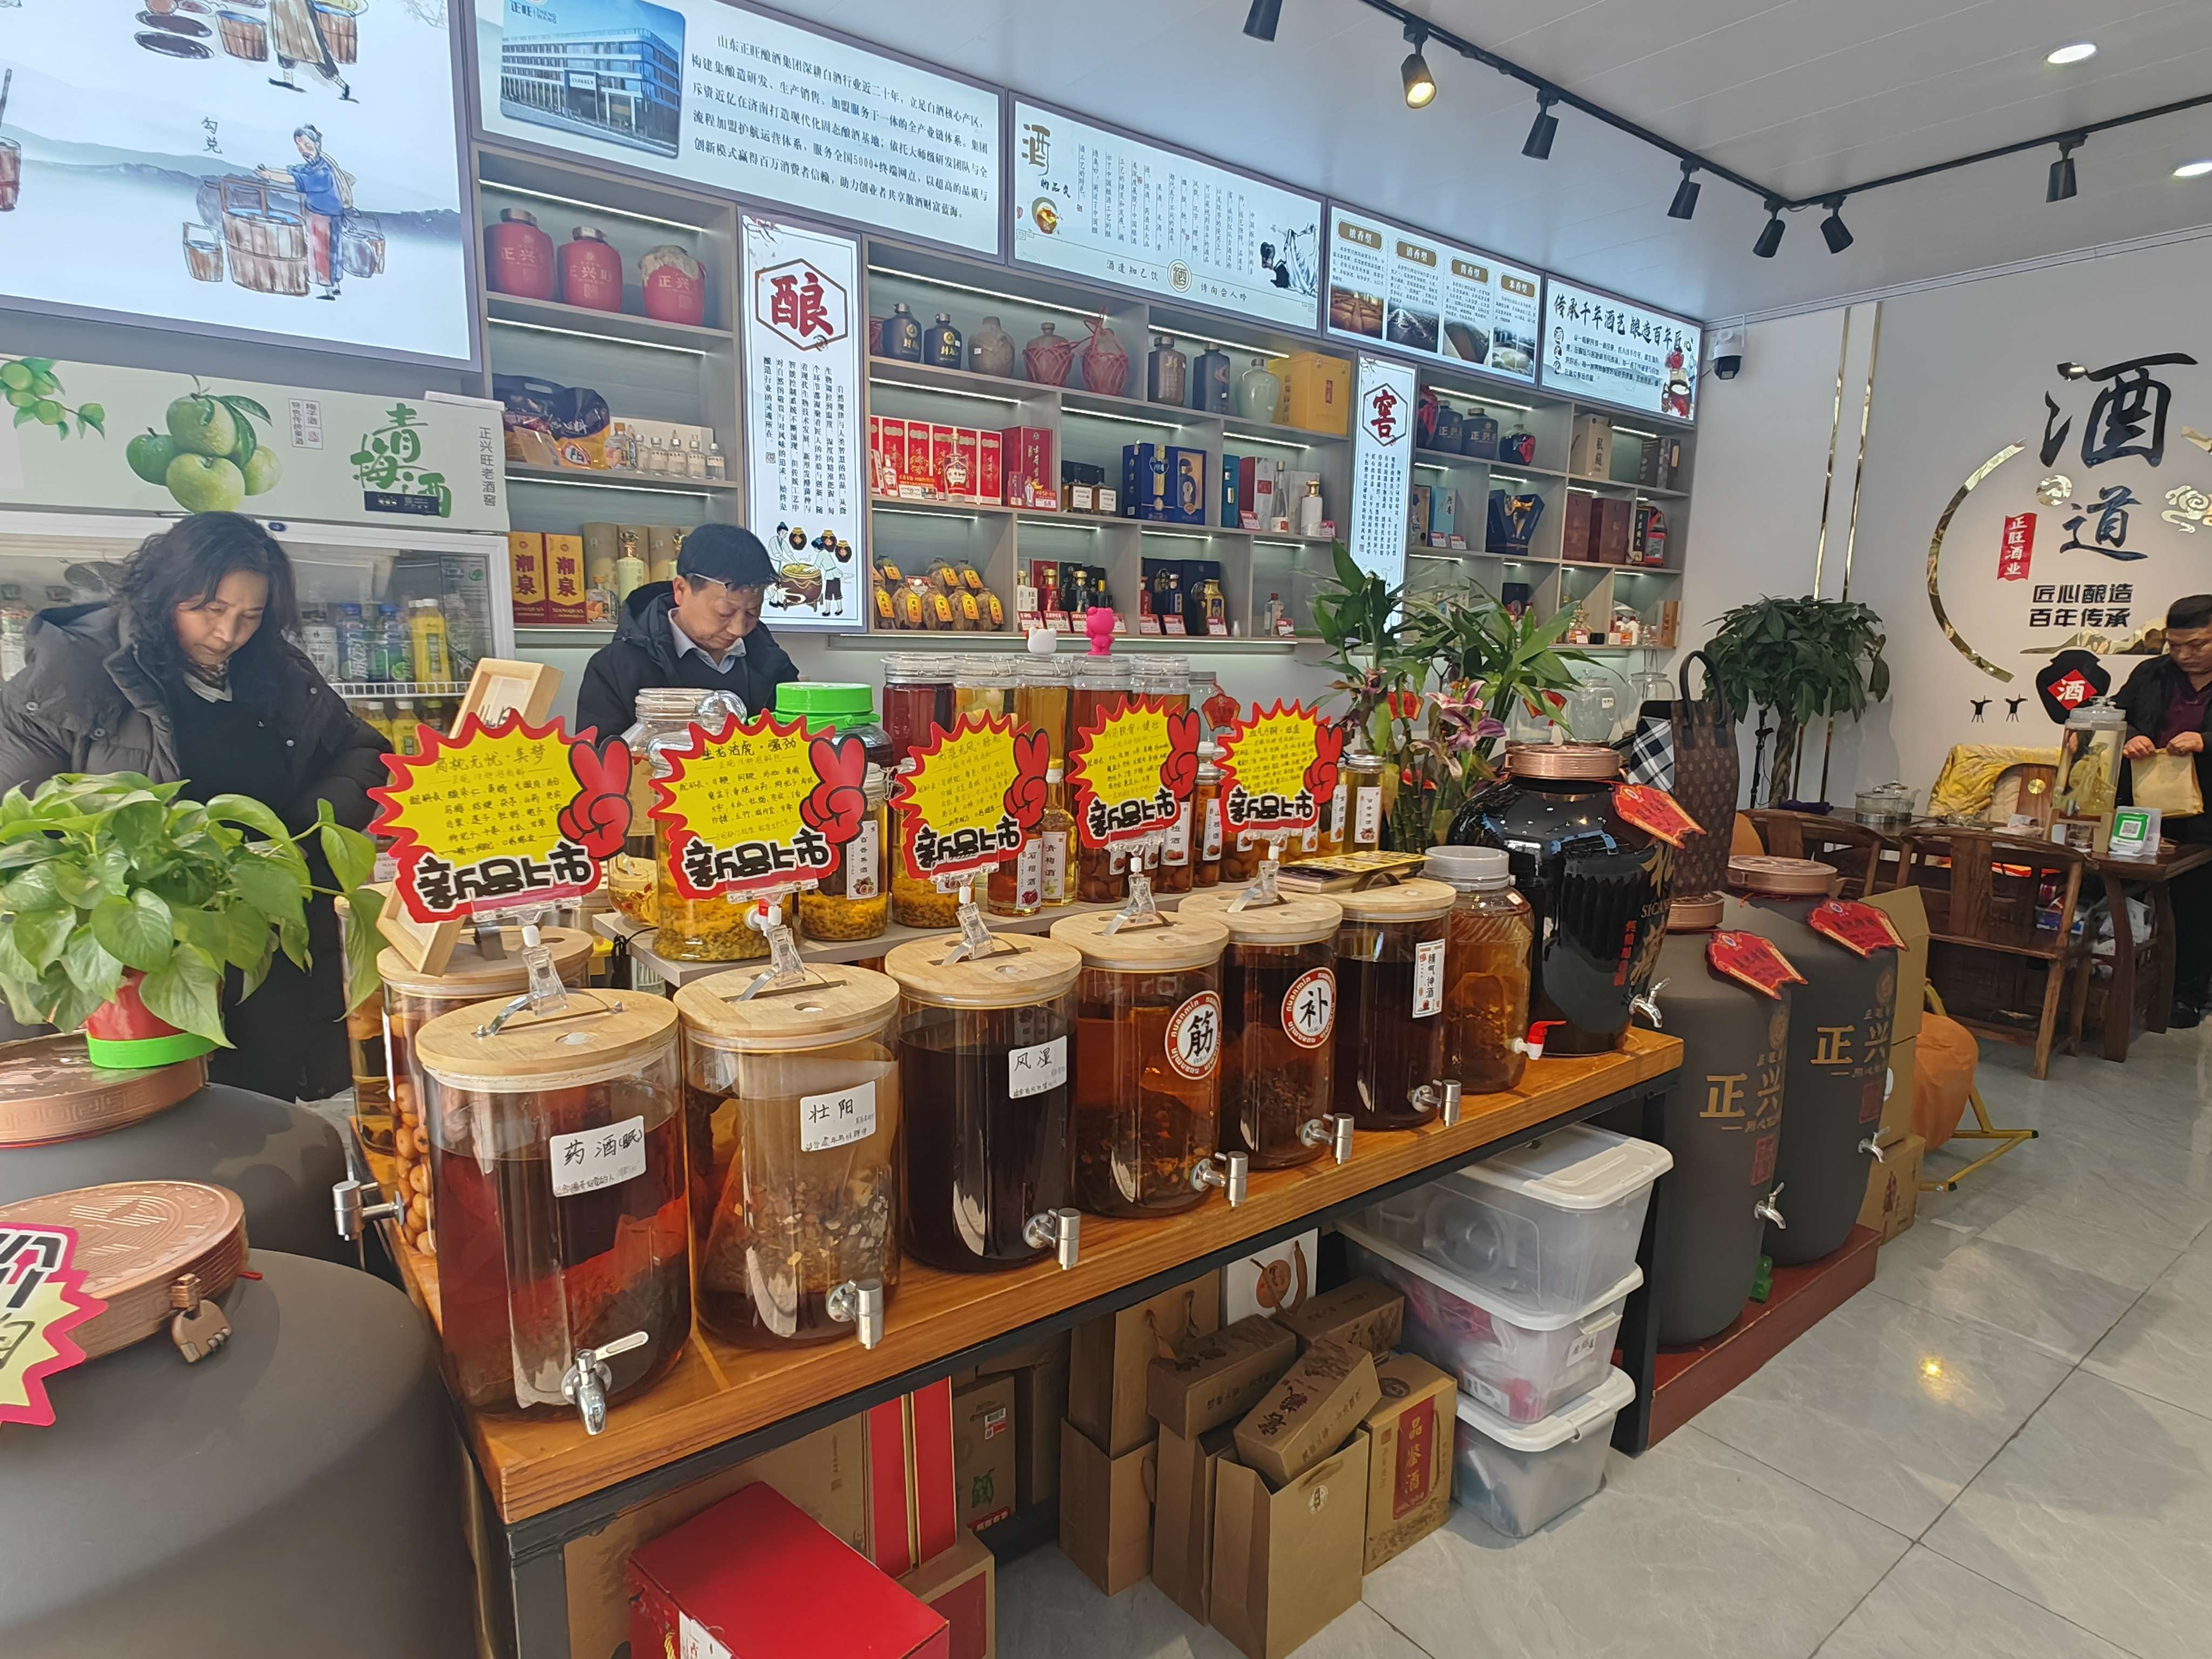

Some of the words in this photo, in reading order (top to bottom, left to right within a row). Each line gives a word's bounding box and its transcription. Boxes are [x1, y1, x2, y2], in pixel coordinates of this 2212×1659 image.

[201, 116, 222, 154] 勾兑
[1022, 124, 1051, 176] 酒
[1107, 259, 1159, 281] 酒逢知己饮
[771, 272, 834, 337] 酿
[1200, 282, 1247, 302] 诗向会人吟
[1371, 389, 1397, 438] 窖
[2004, 515, 2028, 576] 正旺酒业
[515, 554, 537, 595] 湘泉
[556, 556, 578, 597] 湘泉
[2032, 582, 2134, 605] 匠心酿造
[2029, 607, 2131, 629] 百年传承
[2058, 679, 2085, 703] 酒
[1089, 787, 1176, 838] 新品上市
[1229, 790, 1313, 822] 新品上市
[685, 828, 830, 887] 新品上市
[916, 815, 1020, 868] 新品上市
[417, 840, 591, 909] 新品上市
[1299, 987, 1328, 1028] 补
[1184, 1010, 1214, 1061] 筋
[1014, 1047, 1053, 1072] 风湿
[808, 1098, 854, 1124] 壮阳
